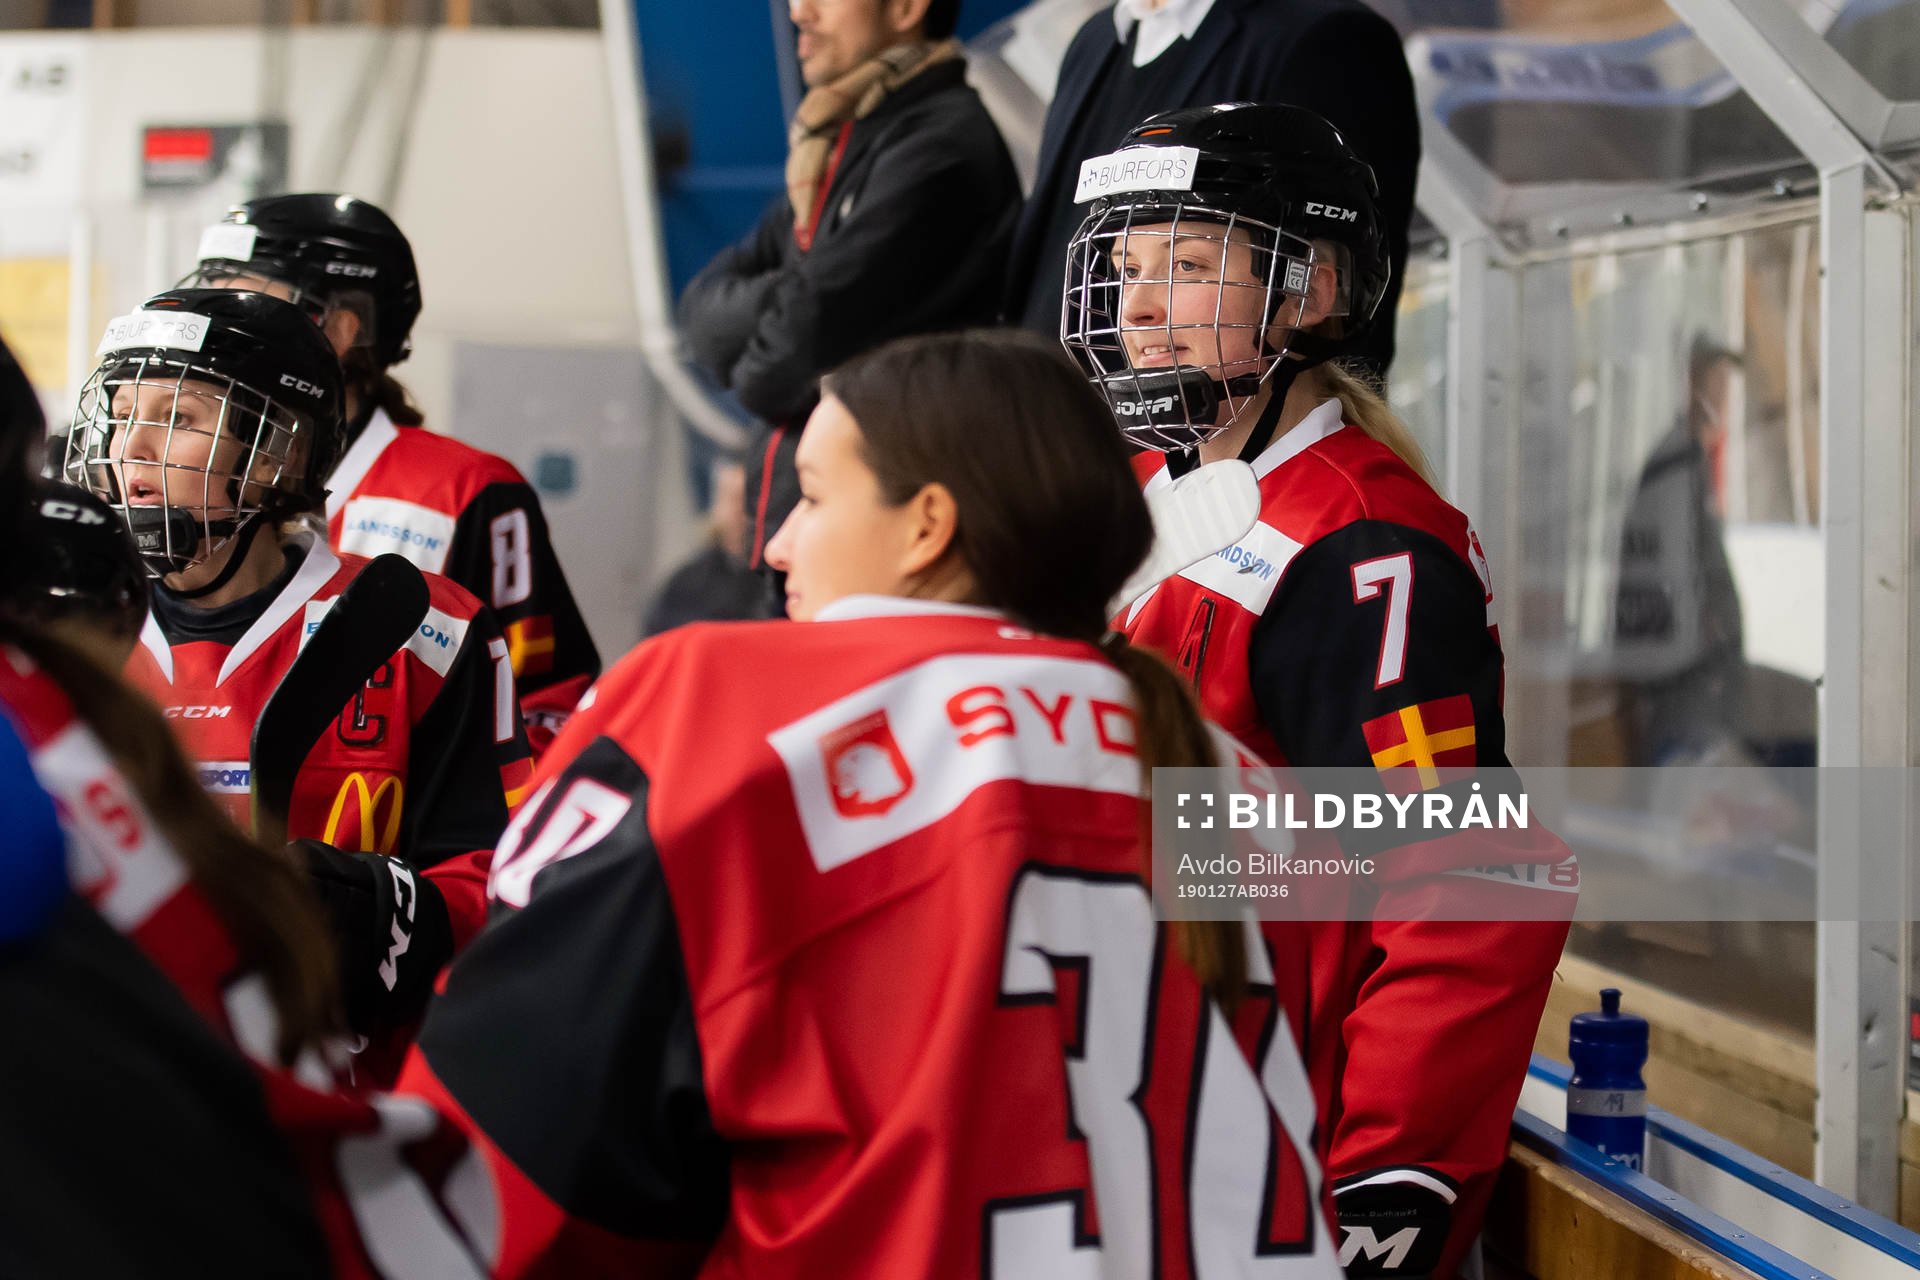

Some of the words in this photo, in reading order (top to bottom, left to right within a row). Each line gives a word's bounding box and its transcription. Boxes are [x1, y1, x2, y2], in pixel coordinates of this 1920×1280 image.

[1099, 159, 1188, 189] BJURFORS
[1306, 202, 1358, 222] CCM
[325, 261, 377, 279] CCM
[279, 373, 325, 399] CCM
[490, 507, 532, 609] 8
[1350, 552, 1413, 690] 7
[163, 705, 232, 719] CCM
